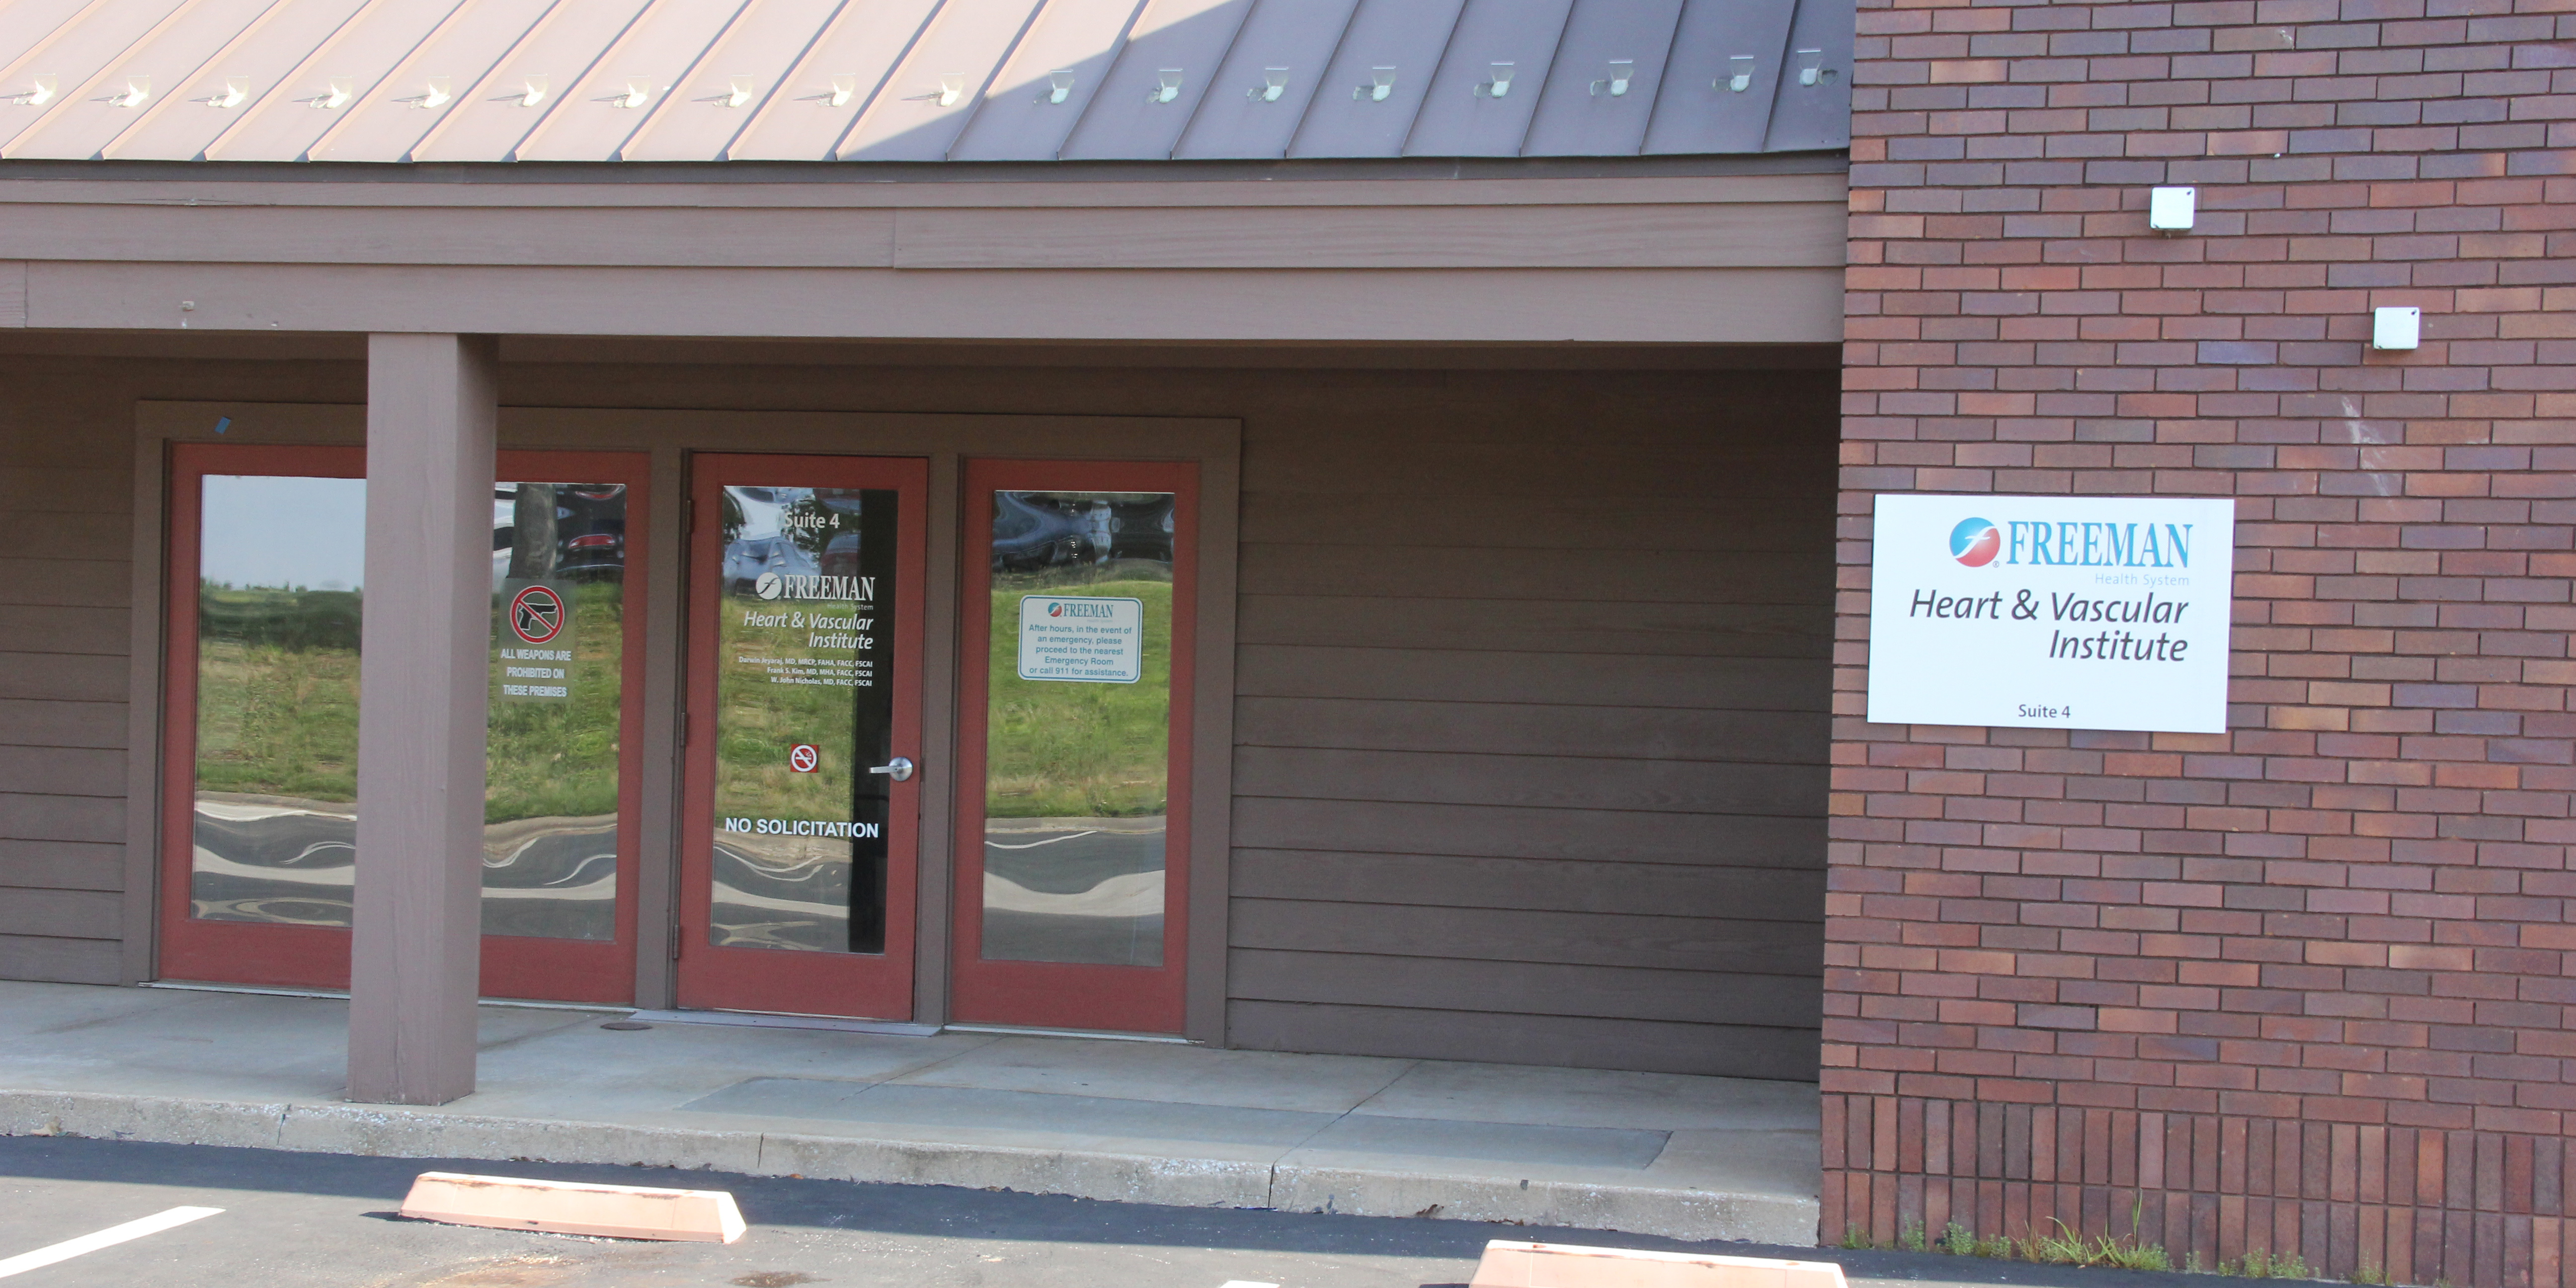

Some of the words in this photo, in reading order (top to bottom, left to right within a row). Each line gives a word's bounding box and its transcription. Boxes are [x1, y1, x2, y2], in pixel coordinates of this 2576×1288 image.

[784, 512, 826, 528] Suite
[829, 513, 840, 528] 4
[2006, 521, 2193, 567] FREEMAN
[785, 574, 875, 601] FREEMAN
[2095, 574, 2137, 585] Health
[2143, 574, 2189, 588] System
[1063, 603, 1114, 618] FREEMAN
[1910, 589, 2002, 619] Heart
[2012, 589, 2039, 620] &
[2052, 592, 2188, 624] Vascular
[744, 611, 787, 627] Heart
[792, 612, 804, 628] &
[810, 614, 873, 630] Vascular
[809, 632, 873, 649] Institute
[2049, 630, 2187, 661] Institute
[501, 648, 515, 658] ALL
[517, 649, 554, 660] WEAPONS
[556, 650, 571, 661] ARE
[1045, 656, 1088, 666] Emergency
[507, 667, 551, 678] PROHIBITED
[553, 669, 564, 679] ON
[503, 685, 527, 695] THESE
[529, 686, 567, 697] PREMISES
[2018, 704, 2057, 718] Suite
[2061, 706, 2071, 718] 4
[725, 817, 751, 833] NO
[756, 818, 879, 838] SOLICITATION
